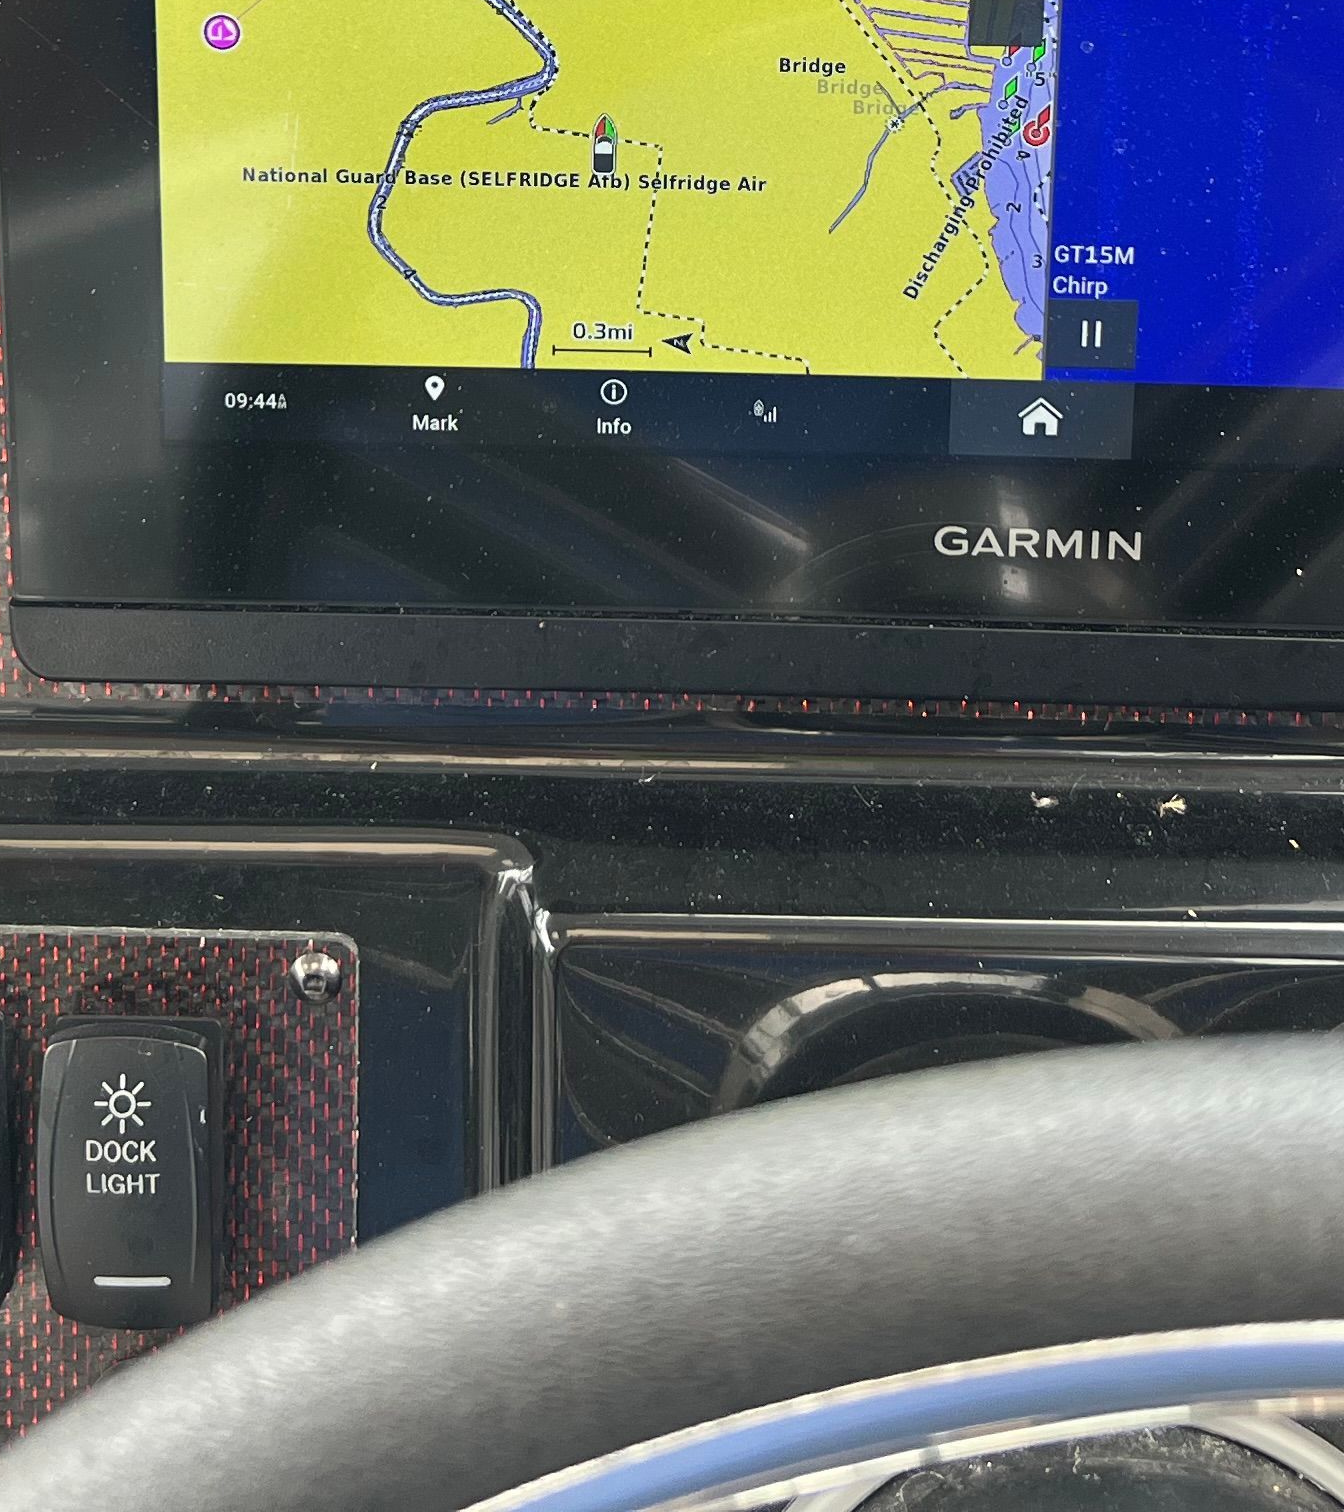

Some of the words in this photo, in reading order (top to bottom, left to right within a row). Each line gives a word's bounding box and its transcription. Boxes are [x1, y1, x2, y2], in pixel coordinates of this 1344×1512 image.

[779, 57, 846, 77] Bridge
[242, 167, 328, 184] National
[335, 168, 396, 185] Guard
[404, 171, 453, 187] Base
[459, 170, 581, 190] (SELFRIDGE
[638, 174, 731, 194] Selfridge
[737, 177, 767, 191] Air
[903, 194, 975, 300] Discharging
[965, 95, 1029, 191] Prohibited
[1053, 245, 1135, 265] GT15M
[1053, 275, 1108, 299] Chirp
[573, 322, 634, 340] 0.3mi
[412, 413, 459, 432] Mark
[597, 417, 632, 434] Info
[933, 525, 1142, 561] GARMIN
[85, 1139, 157, 1164] DOCK
[86, 1171, 160, 1196] LIGHT
